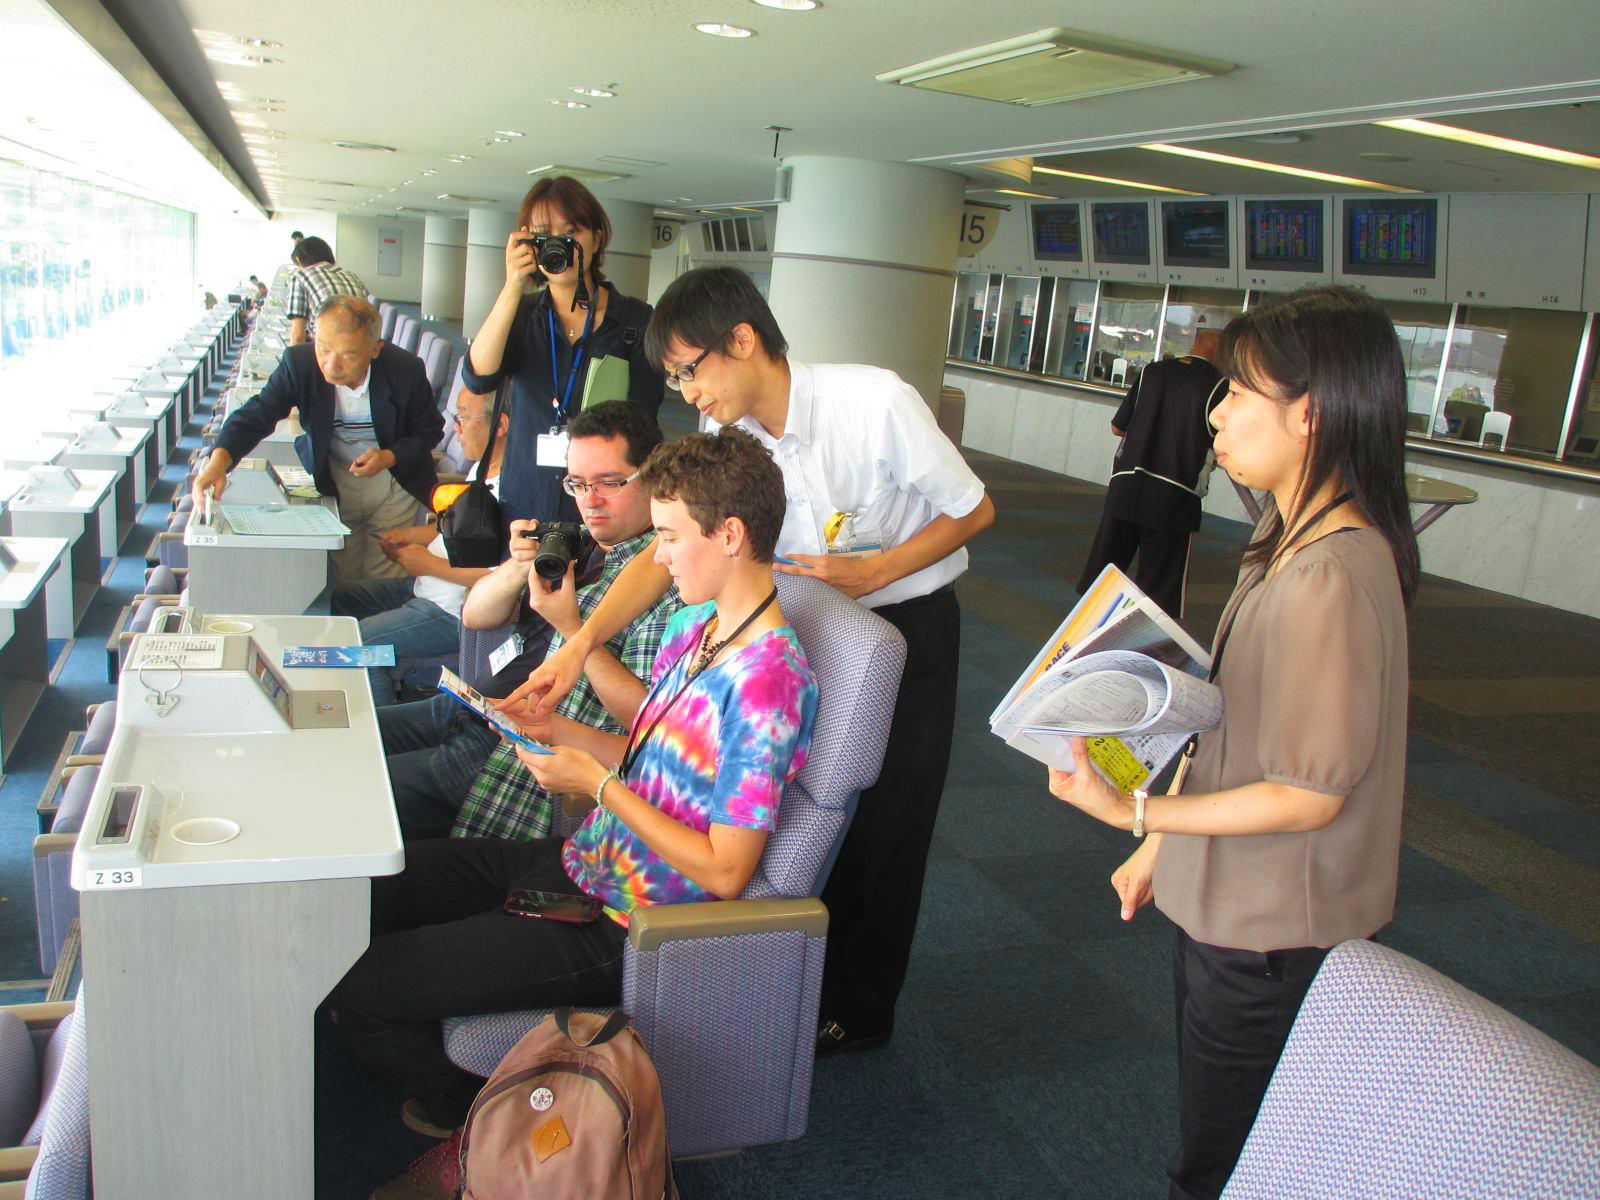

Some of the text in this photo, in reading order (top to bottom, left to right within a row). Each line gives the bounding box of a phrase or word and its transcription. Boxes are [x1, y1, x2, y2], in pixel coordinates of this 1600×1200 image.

[655, 225, 672, 242] 16
[960, 213, 985, 244] 15
[195, 536, 215, 544] Z 35
[95, 871, 134, 885] Z 33
